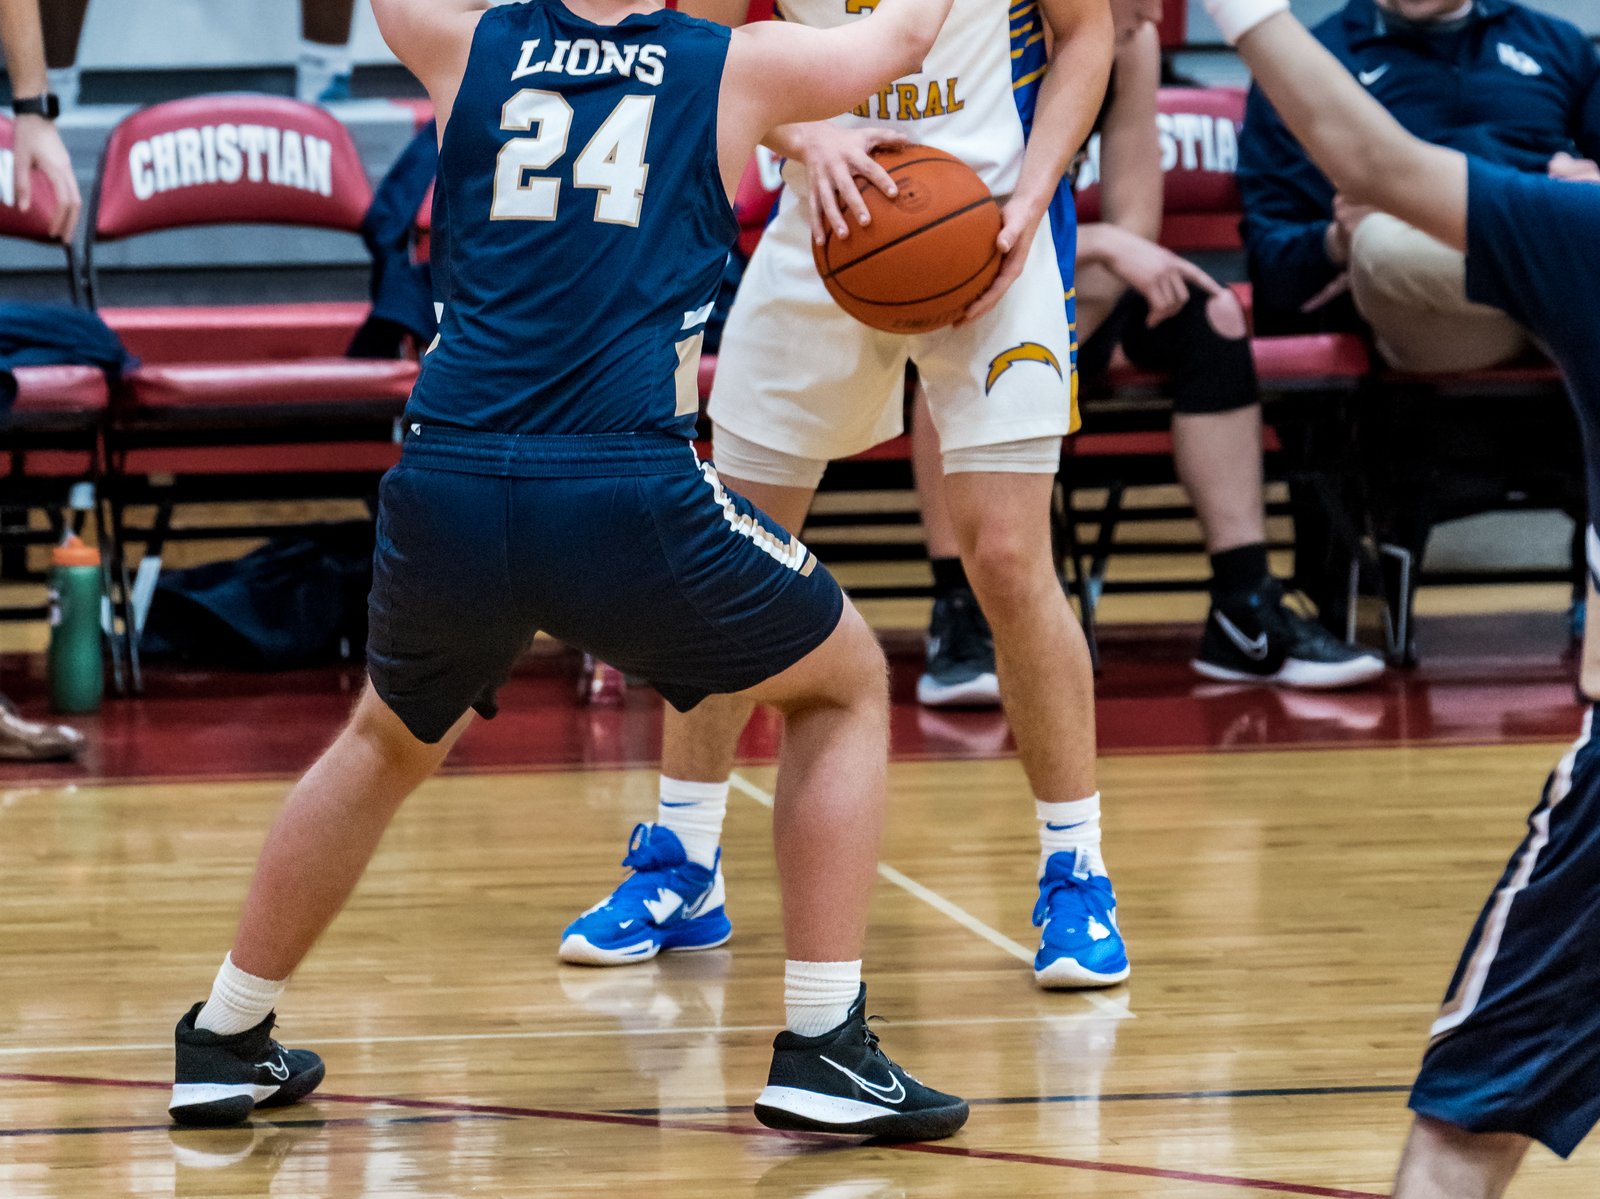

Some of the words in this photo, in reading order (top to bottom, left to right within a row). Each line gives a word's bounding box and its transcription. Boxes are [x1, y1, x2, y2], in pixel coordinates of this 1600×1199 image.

[510, 38, 667, 86] LIONS
[128, 122, 333, 201] CHRISTIAN
[489, 87, 657, 228] 24
